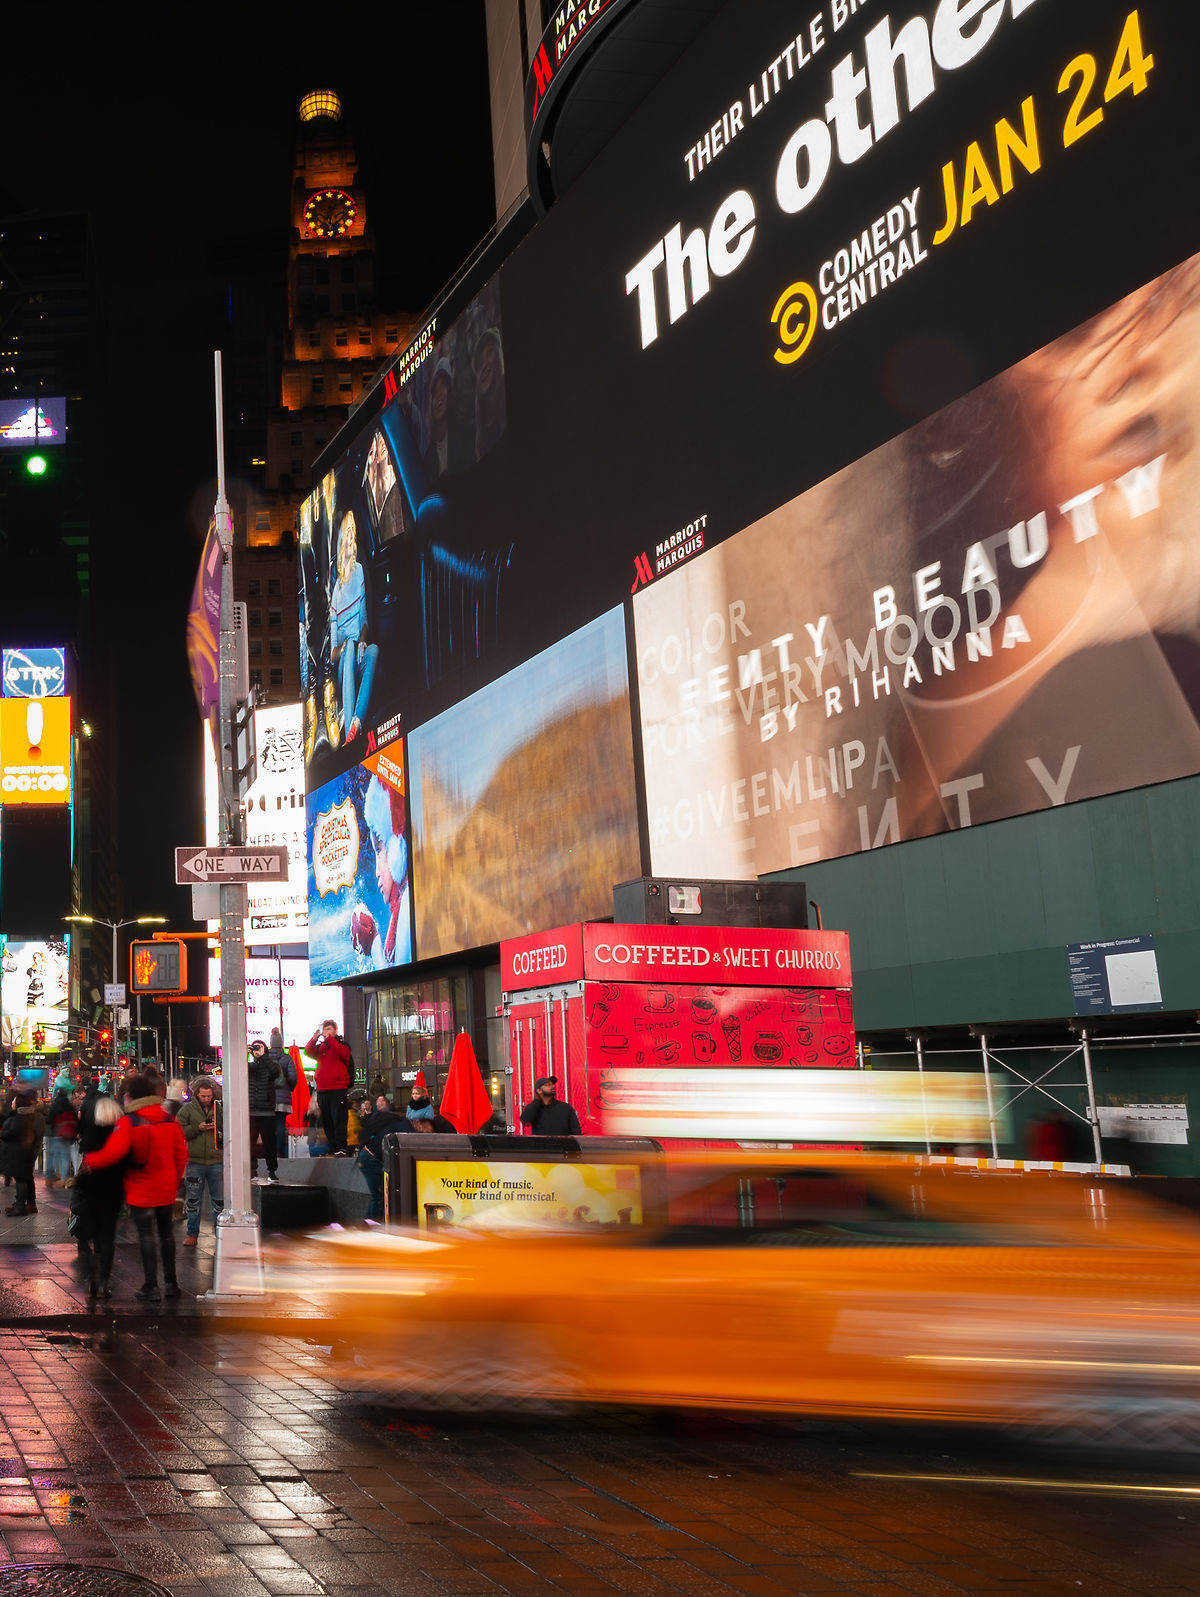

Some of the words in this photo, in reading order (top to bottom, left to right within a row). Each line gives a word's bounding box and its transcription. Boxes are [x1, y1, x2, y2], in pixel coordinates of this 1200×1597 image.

[556, 0, 582, 34] MA
[684, 103, 744, 181] THEIR
[750, 26, 825, 112] LITTLE
[831, 0, 868, 33] B
[933, 95, 1043, 246] JAN
[1057, 9, 1155, 150] 24
[624, 189, 758, 351] The
[774, 0, 1038, 216] othe
[818, 187, 921, 293] COMEDY
[821, 239, 928, 332] CENTRAL
[400, 318, 437, 372] MARRIOTT
[400, 340, 434, 387] MARQUIS
[655, 515, 708, 556] MARRIOTT
[872, 453, 1168, 632] BEAUTY
[656, 534, 704, 572] MARQUIS
[640, 598, 752, 686] COLOR
[845, 580, 1002, 684] MOOD
[18, 666, 61, 681] TDK
[759, 701, 801, 743] BY
[825, 614, 1032, 719] RIHANNA
[376, 713, 402, 735] MARRIOTT
[377, 727, 400, 746] MARQUIS
[379, 754, 402, 776] EXTENDED
[318, 829, 352, 854] SPECTACULAR
[321, 814, 348, 840] CHRISTMAS
[193, 858, 225, 873] ONE
[239, 857, 274, 872] WAY
[321, 845, 349, 866] ROCKETTES
[512, 943, 567, 976] COFFEED
[594, 943, 710, 967] COFFEED
[712, 952, 721, 963] &
[723, 947, 770, 969] SWEET
[775, 950, 842, 970] CHURROS
[246, 977, 281, 987] wants
[282, 978, 294, 987] to
[633, 1016, 680, 1033] Espresso
[744, 1000, 771, 1021] Latte
[441, 1178, 464, 1189] Your
[465, 1178, 488, 1189] kind
[490, 1178, 502, 1189] of
[502, 1179, 534, 1190] music.
[455, 1189, 478, 1200] Your
[479, 1190, 502, 1201] kind
[504, 1190, 516, 1201] of
[516, 1191, 558, 1202] musical.
